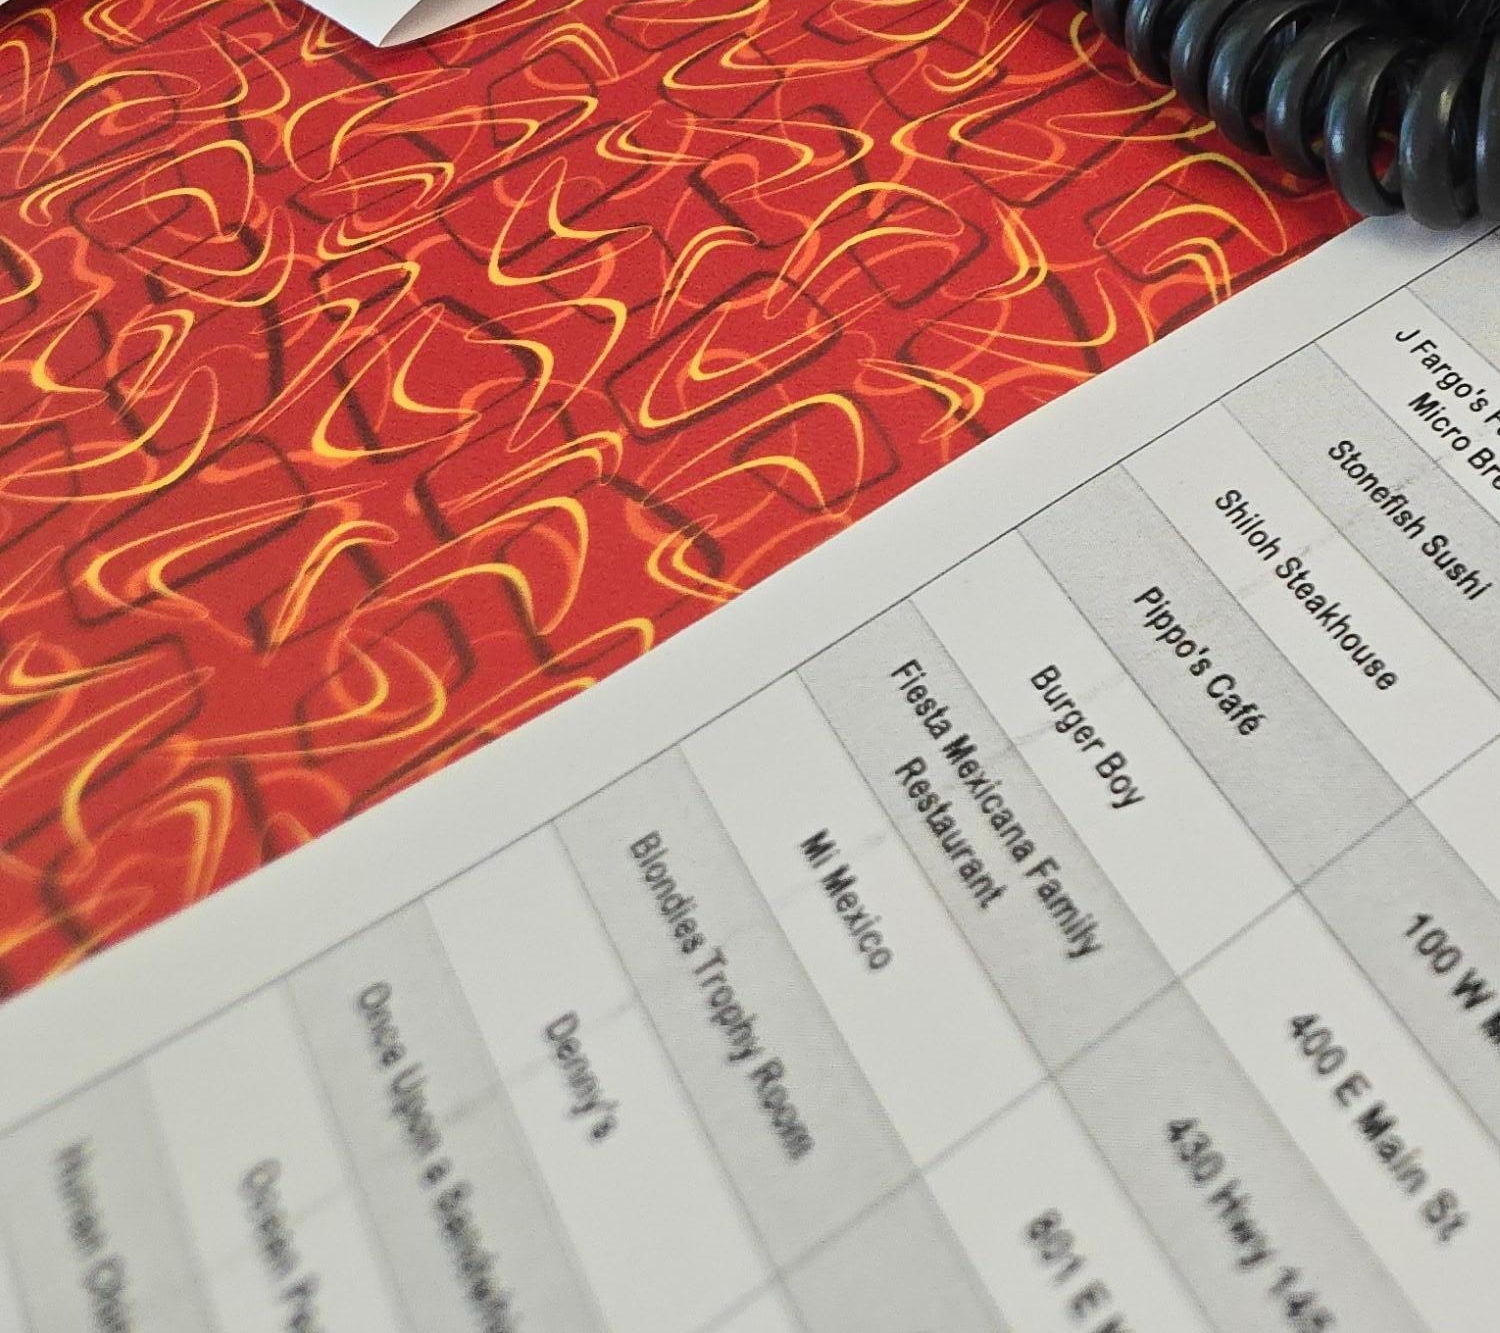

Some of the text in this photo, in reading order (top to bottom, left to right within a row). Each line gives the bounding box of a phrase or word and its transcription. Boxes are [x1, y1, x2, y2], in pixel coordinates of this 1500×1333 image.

[1395, 328, 1421, 344] J
[1408, 338, 1489, 414] Fargo's
[1407, 390, 1472, 455] Micro
[1215, 488, 1399, 693] Shiloh Steakhouse
[1327, 439, 1494, 603] Stonefish Sushi
[1133, 584, 1267, 738] Pippo's Café
[890, 658, 1104, 962] Fiesta Mexicana Family
[1029, 664, 1146, 812] Burger Boy
[799, 827, 892, 973] Mi Mexico
[894, 755, 1006, 911] Restaurant
[629, 829, 816, 1163] Blondies Trophy Room
[1401, 911, 1464, 975] 100
[1451, 967, 1496, 1012] W
[544, 1009, 621, 1144] Denny's
[1354, 1100, 1430, 1197] Main
